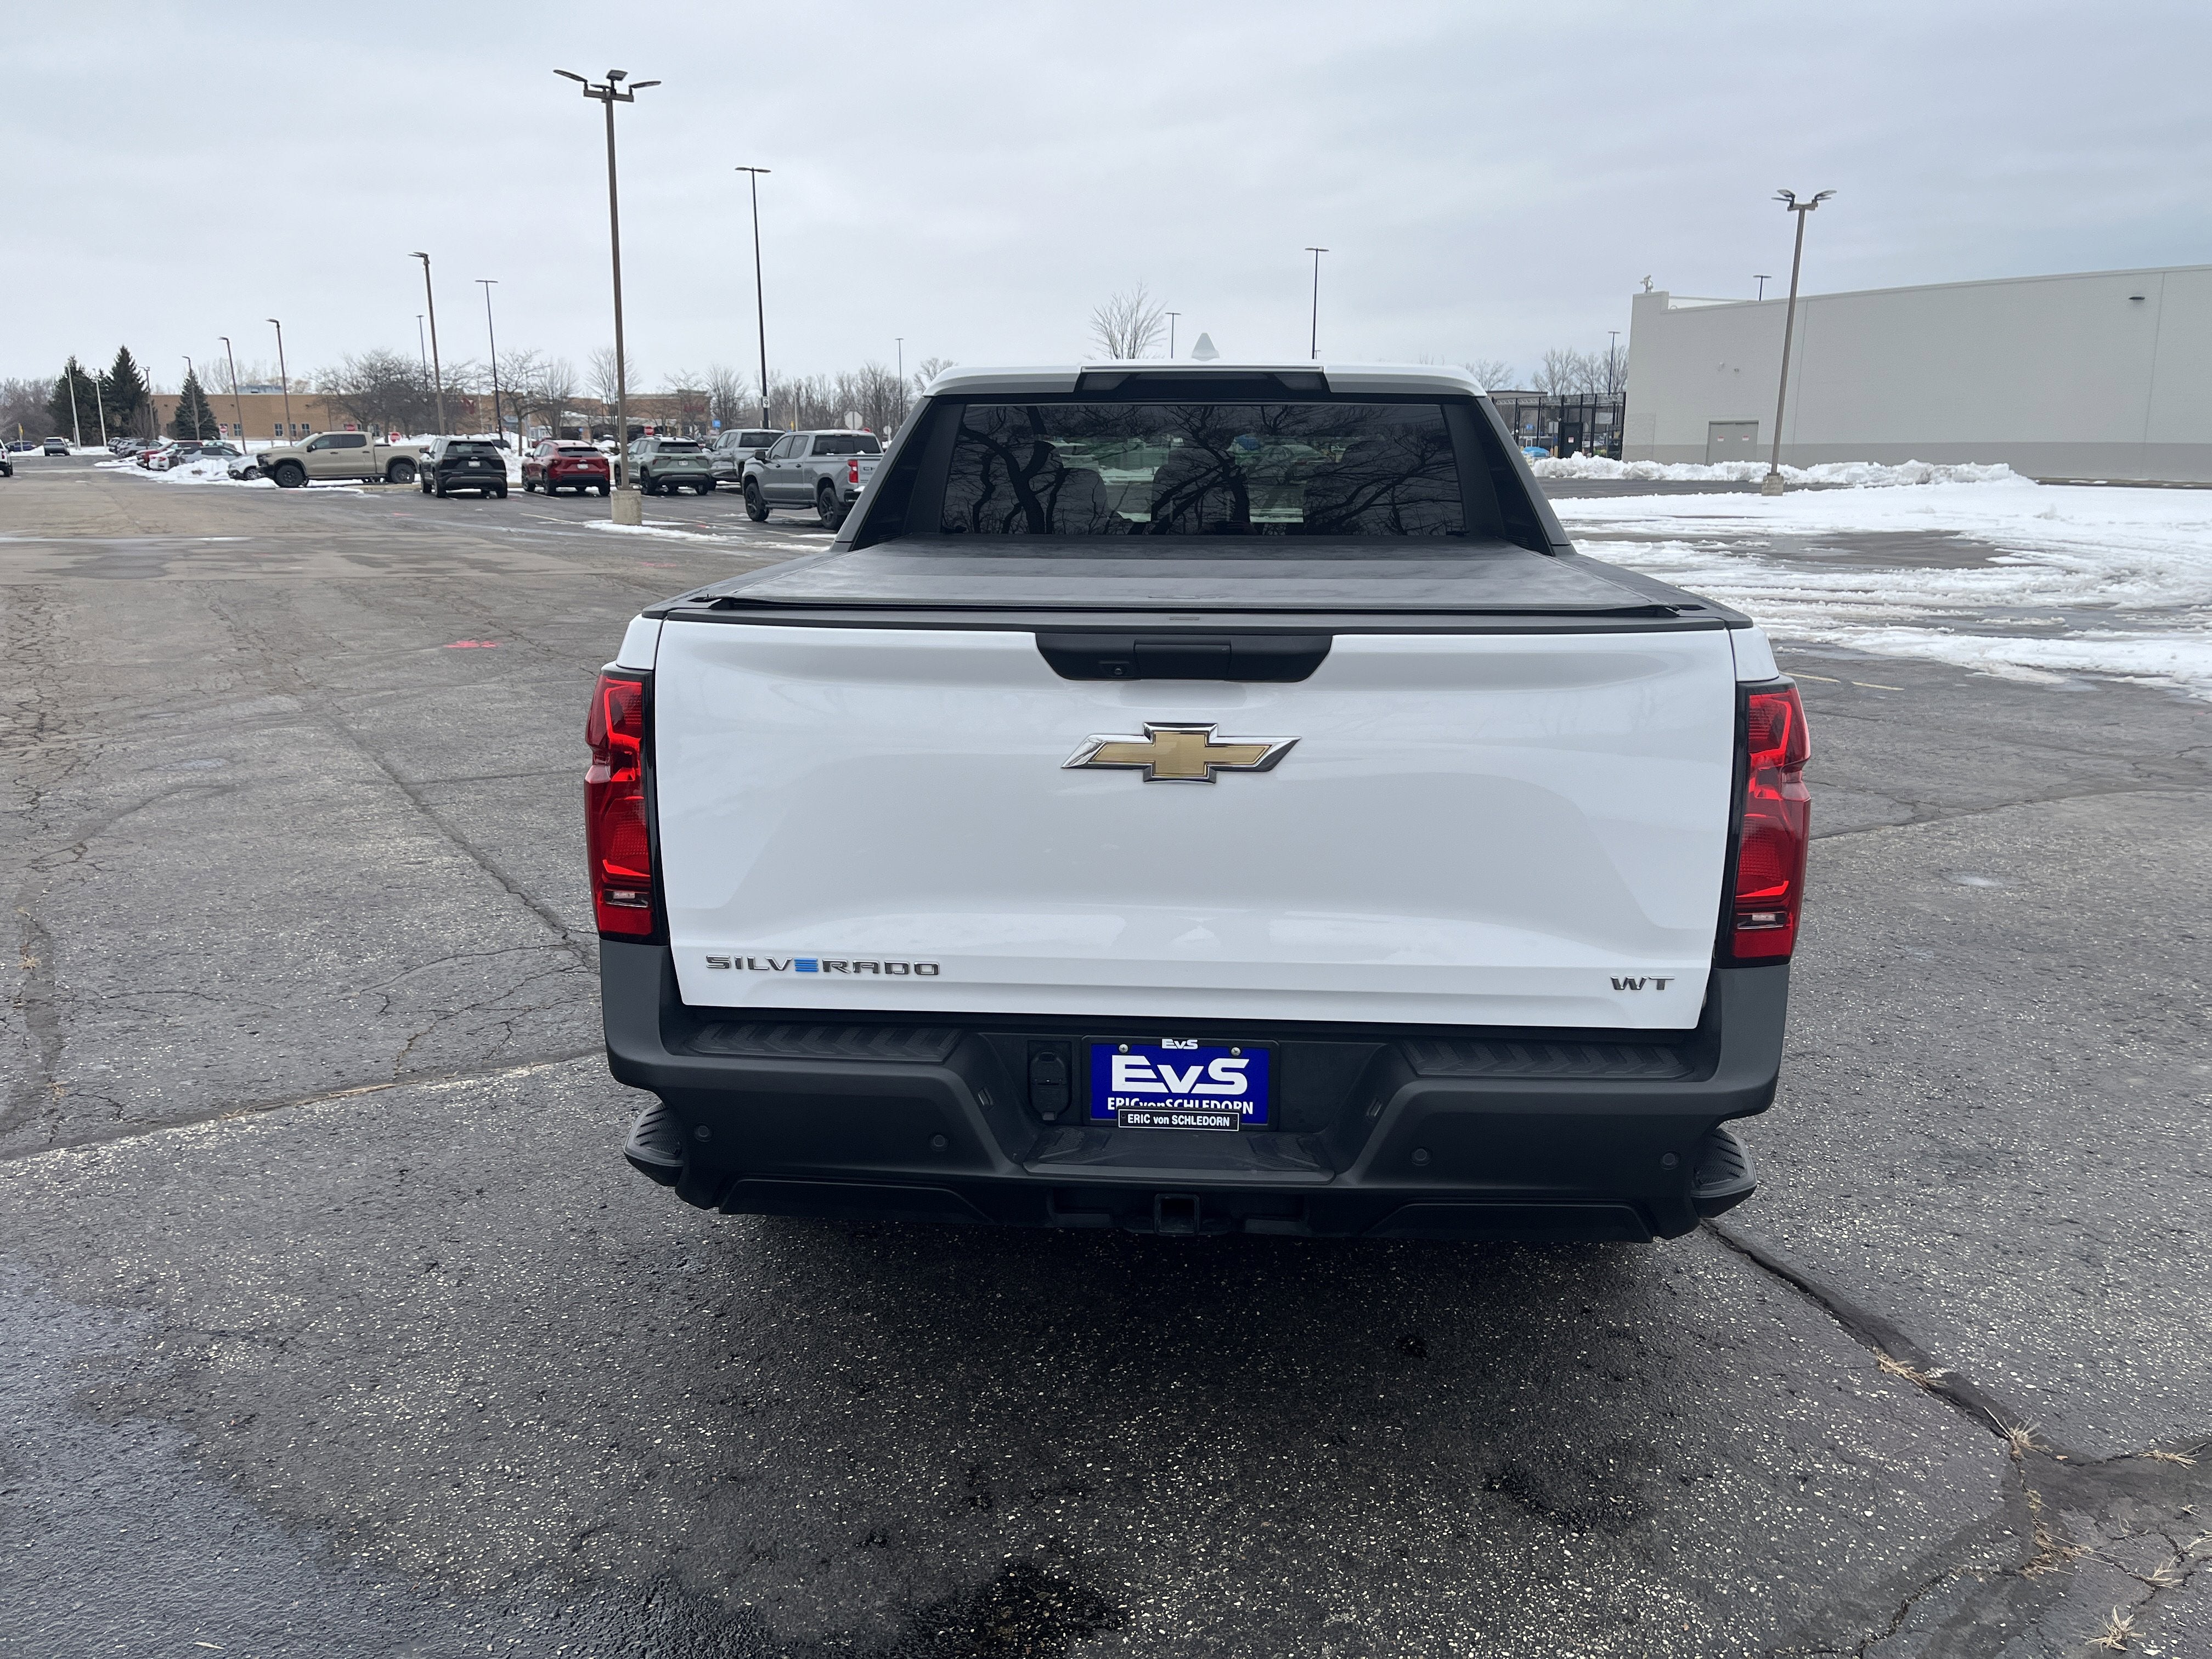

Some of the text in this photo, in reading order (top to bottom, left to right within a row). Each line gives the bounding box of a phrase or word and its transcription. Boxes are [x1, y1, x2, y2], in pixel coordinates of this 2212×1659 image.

[706, 955, 940, 975] SILVERADO
[1610, 975, 1675, 990] WT
[1127, 1114, 1230, 1127] ERIC von SCHLEDORN
